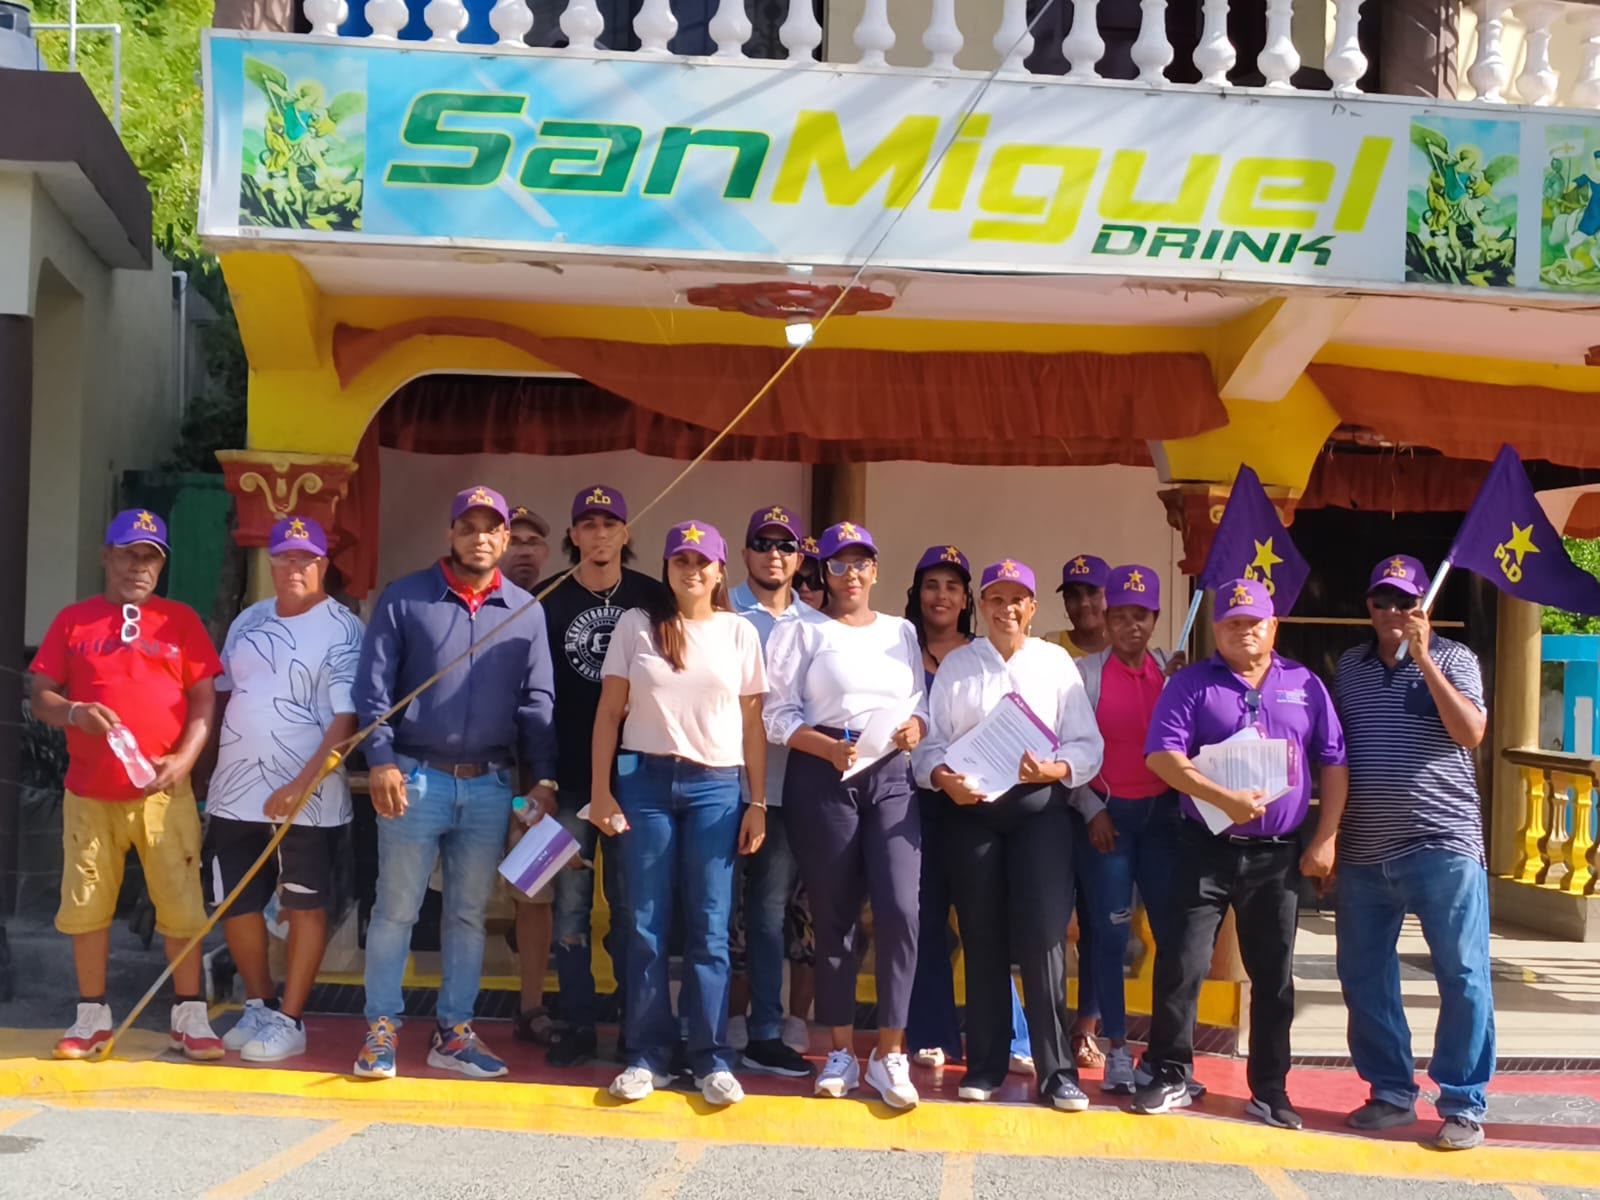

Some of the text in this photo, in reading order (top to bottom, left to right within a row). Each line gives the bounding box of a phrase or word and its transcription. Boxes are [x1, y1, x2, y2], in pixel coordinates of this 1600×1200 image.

[1091, 223, 1336, 266] DRINK
[468, 494, 494, 505] PLD
[586, 495, 611, 505] PLD
[764, 513, 789, 523] PLD
[133, 520, 157, 533] PLD
[285, 529, 309, 539] PLD
[838, 531, 862, 541] PLD
[940, 553, 961, 564] PLD
[1494, 543, 1522, 583] PLD
[997, 569, 1020, 578] PLD
[1070, 567, 1089, 575] PLD
[1383, 567, 1406, 578] PLD
[1124, 582, 1145, 592] PLD
[1229, 595, 1254, 607] PLD
[568, 608, 622, 642] EVERYBODYF
[579, 663, 600, 679] BOXI
